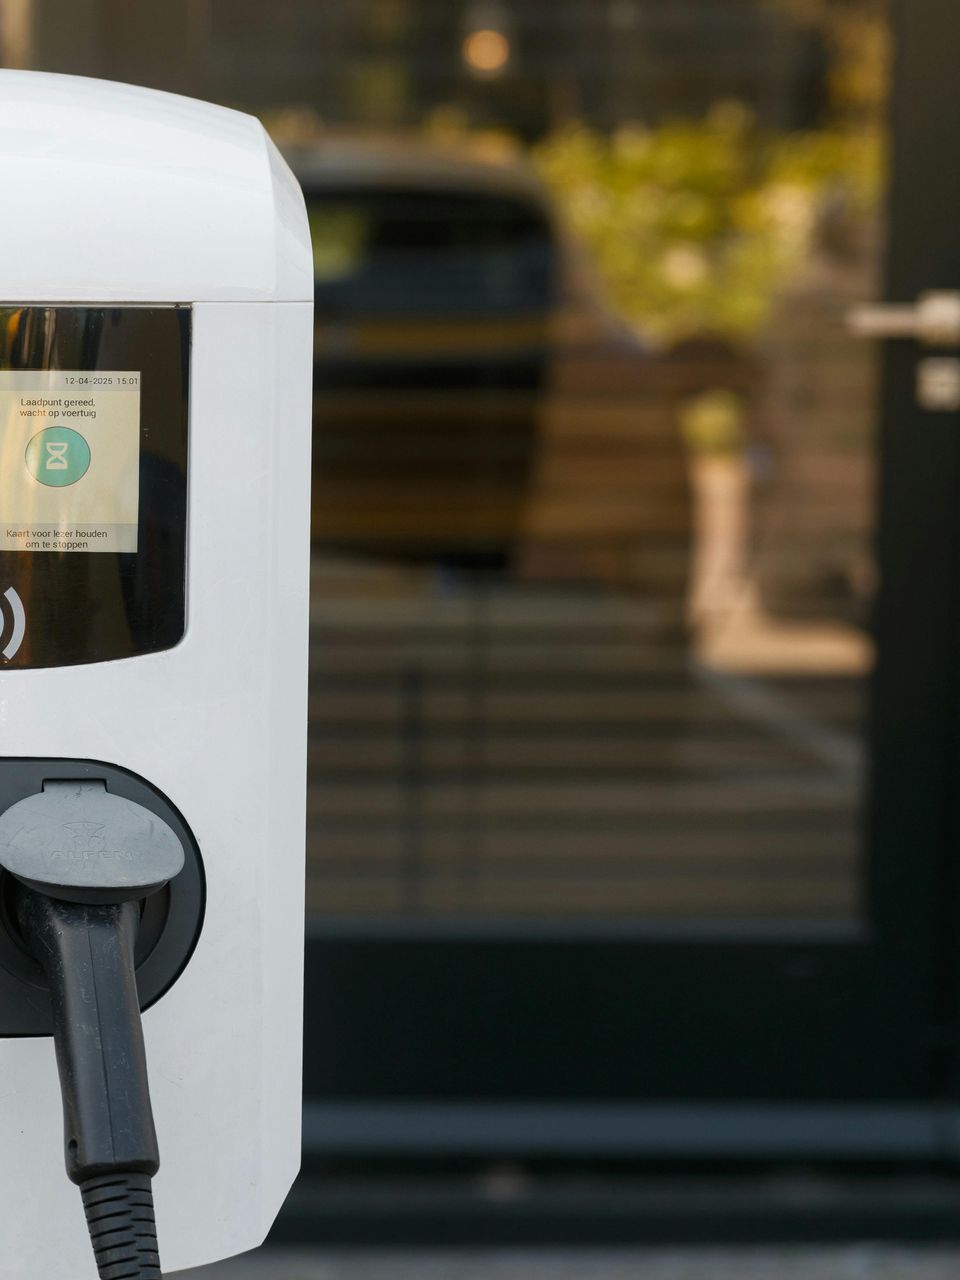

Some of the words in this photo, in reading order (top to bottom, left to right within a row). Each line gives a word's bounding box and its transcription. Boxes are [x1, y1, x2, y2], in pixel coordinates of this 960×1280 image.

[64, 377, 113, 385] 12-04-2025
[117, 377, 138, 385] 15:01
[20, 398, 62, 408] Laadpunt
[63, 398, 96, 408] gereed,
[19, 409, 47, 418] wacht
[48, 410, 60, 419] op
[61, 409, 97, 419] voertuig
[6, 529, 30, 538] Kaart
[31, 530, 52, 538] voor
[53, 529, 74, 538] lezer
[75, 529, 108, 538] houden
[25, 541, 40, 549] om
[42, 541, 51, 549] te
[52, 541, 89, 551] stoppen
[50, 849, 134, 863] ALFEN
